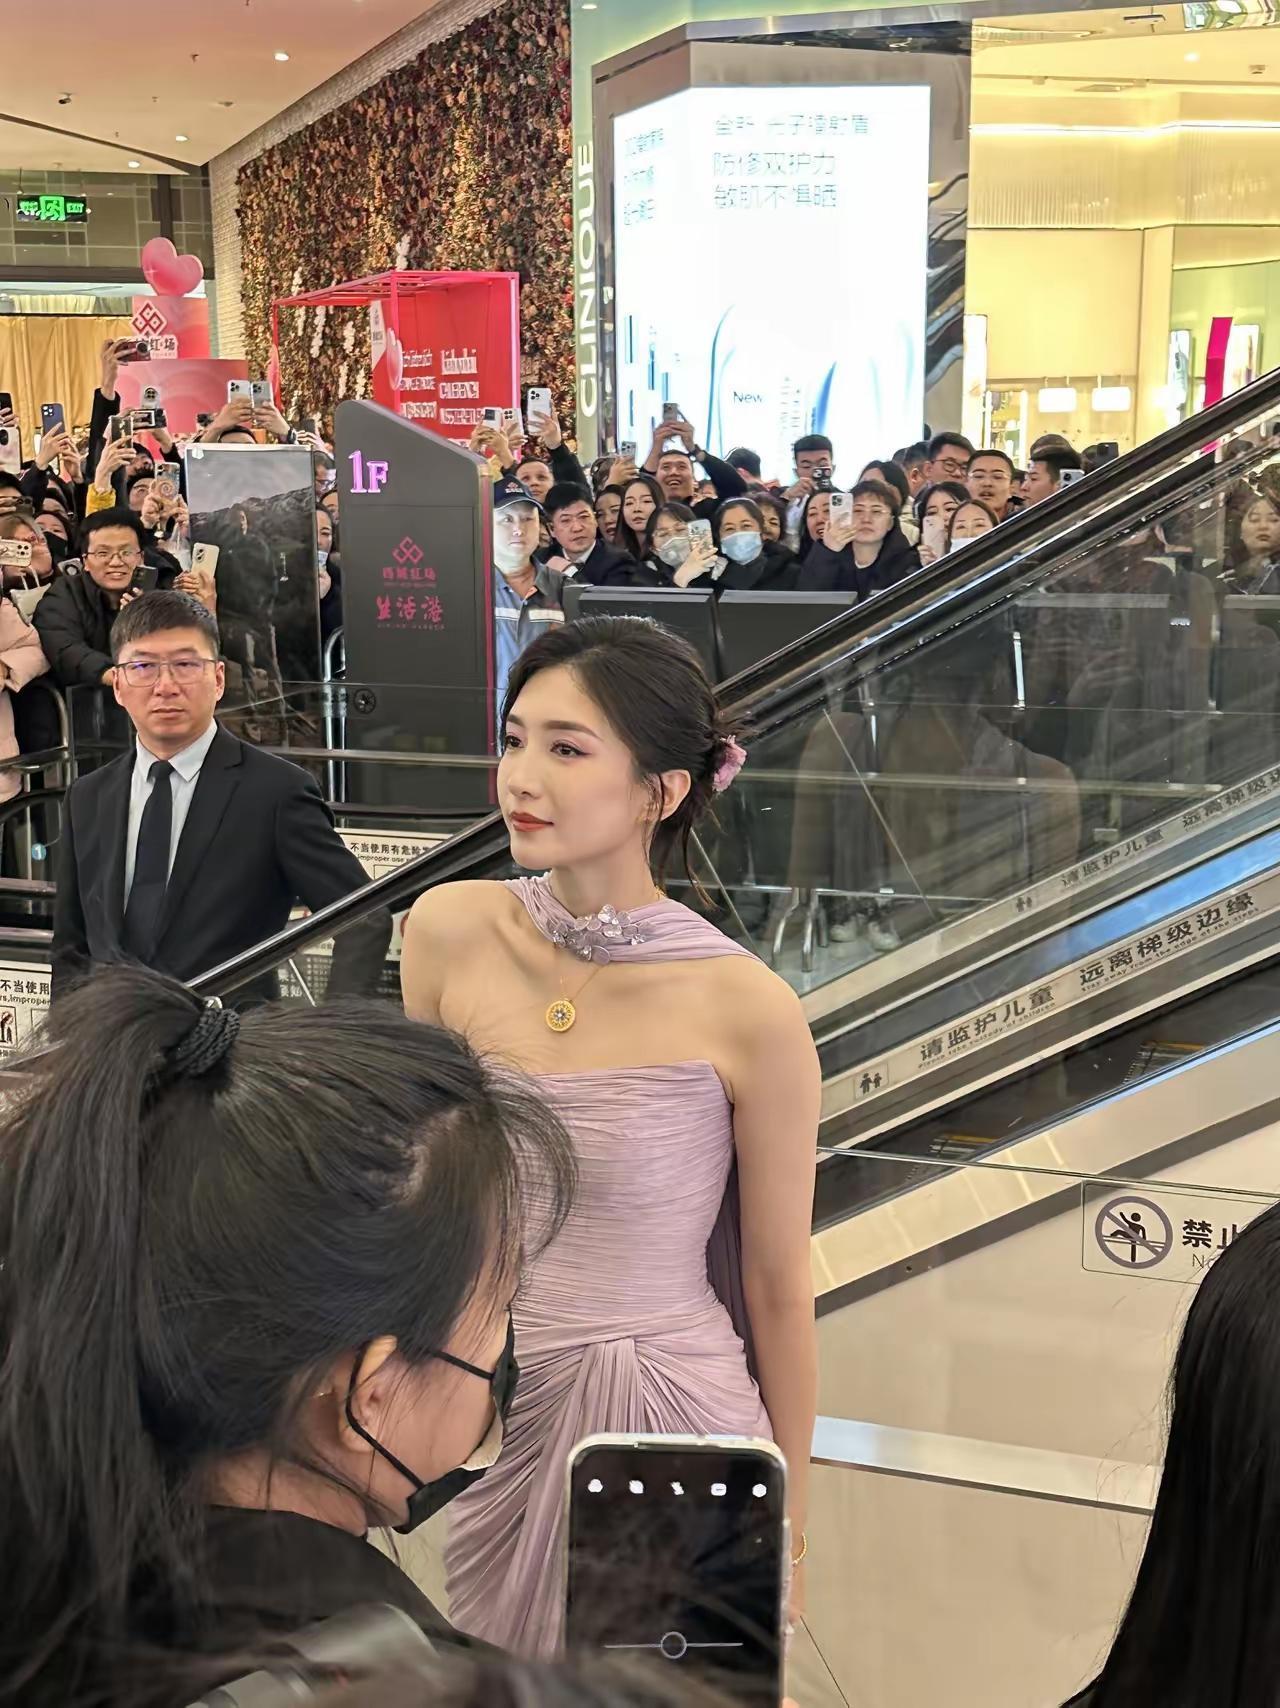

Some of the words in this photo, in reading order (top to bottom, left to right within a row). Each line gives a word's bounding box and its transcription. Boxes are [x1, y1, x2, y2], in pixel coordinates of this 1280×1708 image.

[578, 141, 598, 417] CLINIQUE
[348, 450, 388, 493] 1F
[1080, 892, 1254, 985] 远离梯级边缘
[920, 985, 1054, 1061] 请监护儿童
